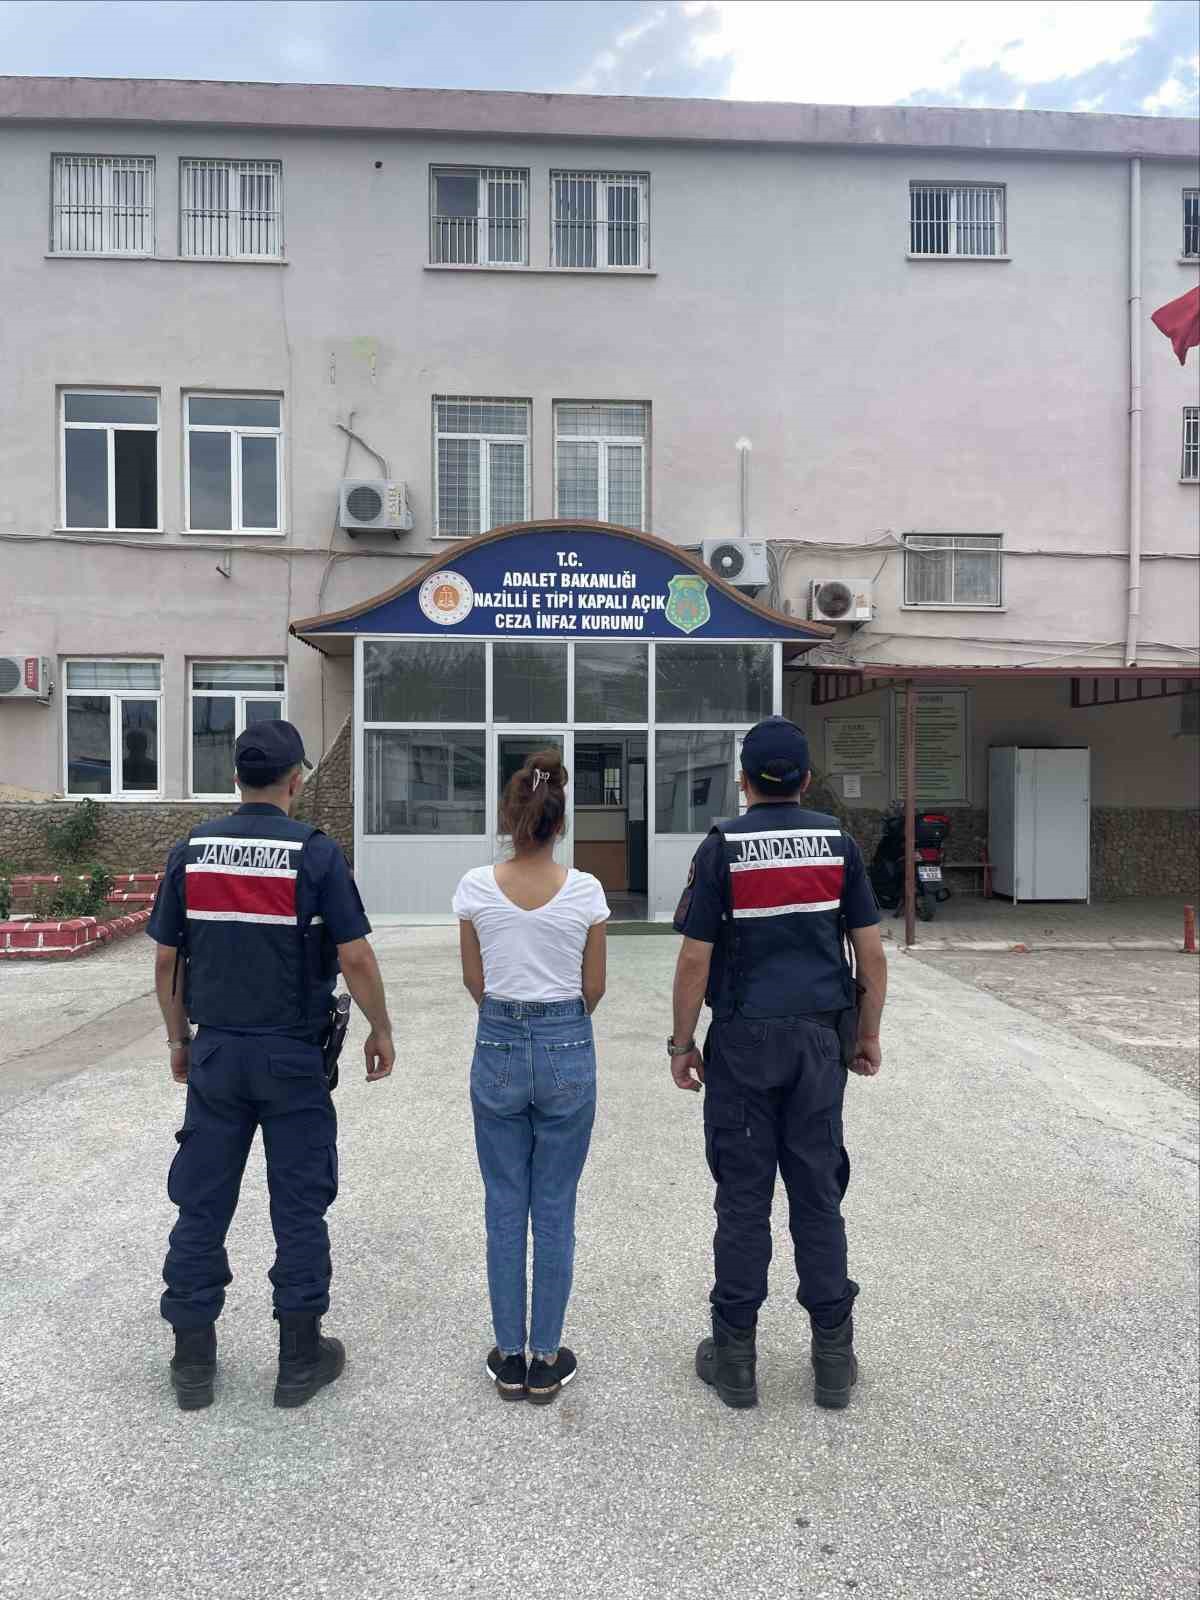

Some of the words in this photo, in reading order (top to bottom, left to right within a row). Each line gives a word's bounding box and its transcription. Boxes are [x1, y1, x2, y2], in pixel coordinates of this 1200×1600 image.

[557, 552, 583, 567] T.C.
[503, 572, 557, 587] ADALET
[561, 571, 636, 588] BAKANLIĞI
[473, 590, 527, 608] NAZİLLİ
[532, 594, 541, 608] E
[545, 591, 573, 609] TİPİ
[578, 594, 627, 609] KAPALI
[632, 595, 666, 613] AÇIK
[495, 614, 532, 629] CEZA
[536, 612, 577, 630] İNFAZ
[581, 615, 644, 630] KURUMU
[197, 844, 290, 869] JANDARMA
[737, 836, 832, 861] JANDARMA
